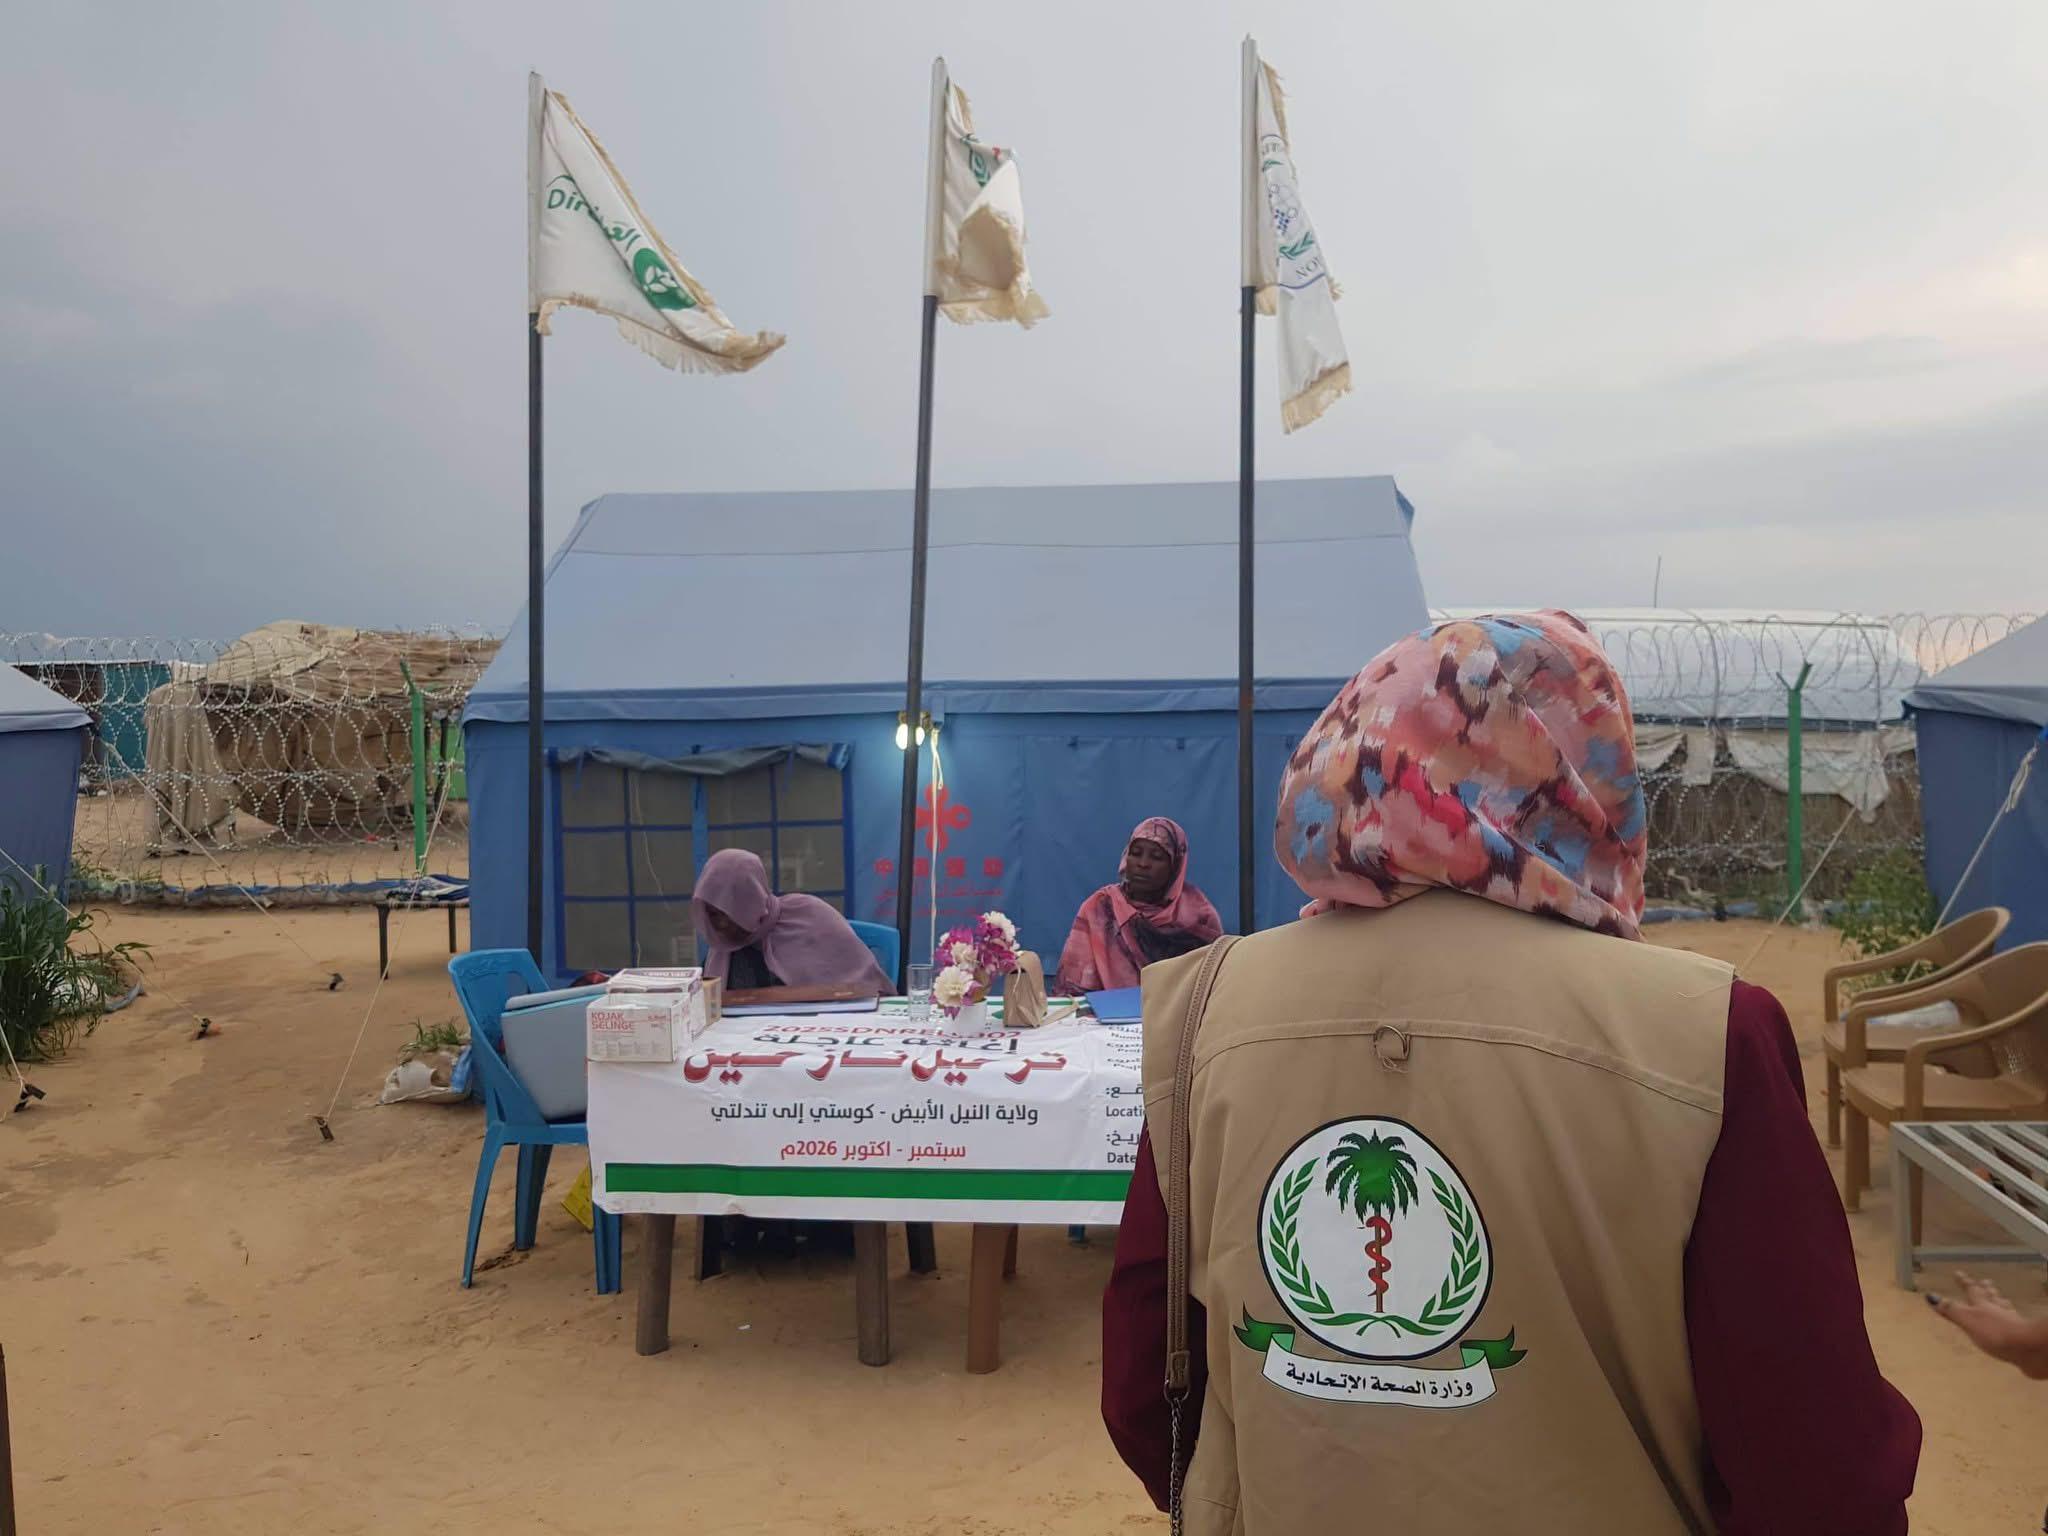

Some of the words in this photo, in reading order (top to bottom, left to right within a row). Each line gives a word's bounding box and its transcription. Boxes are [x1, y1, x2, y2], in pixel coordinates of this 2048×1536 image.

[547, 189, 584, 211] Dir
[591, 1012, 625, 1021] KOJAK
[753, 1034, 884, 1047] عاجلة
[684, 1048, 908, 1086] نازحين
[912, 1049, 1068, 1086] ترحيل
[711, 1103, 768, 1122] تندلتي
[772, 1103, 804, 1124] إلى
[809, 1103, 874, 1124] كوستي
[892, 1099, 944, 1124] الأبيض
[950, 1104, 989, 1124] النيل
[995, 1104, 1038, 1125] ولاية
[1106, 1106, 1144, 1118] Locati
[841, 1140, 891, 1161] اكتوبر
[907, 1141, 966, 1162] سبتمبر
[1285, 1362, 1366, 1394] الإتحادية
[1371, 1376, 1426, 1395] الصحة
[1430, 1379, 1473, 1398] وزارة
